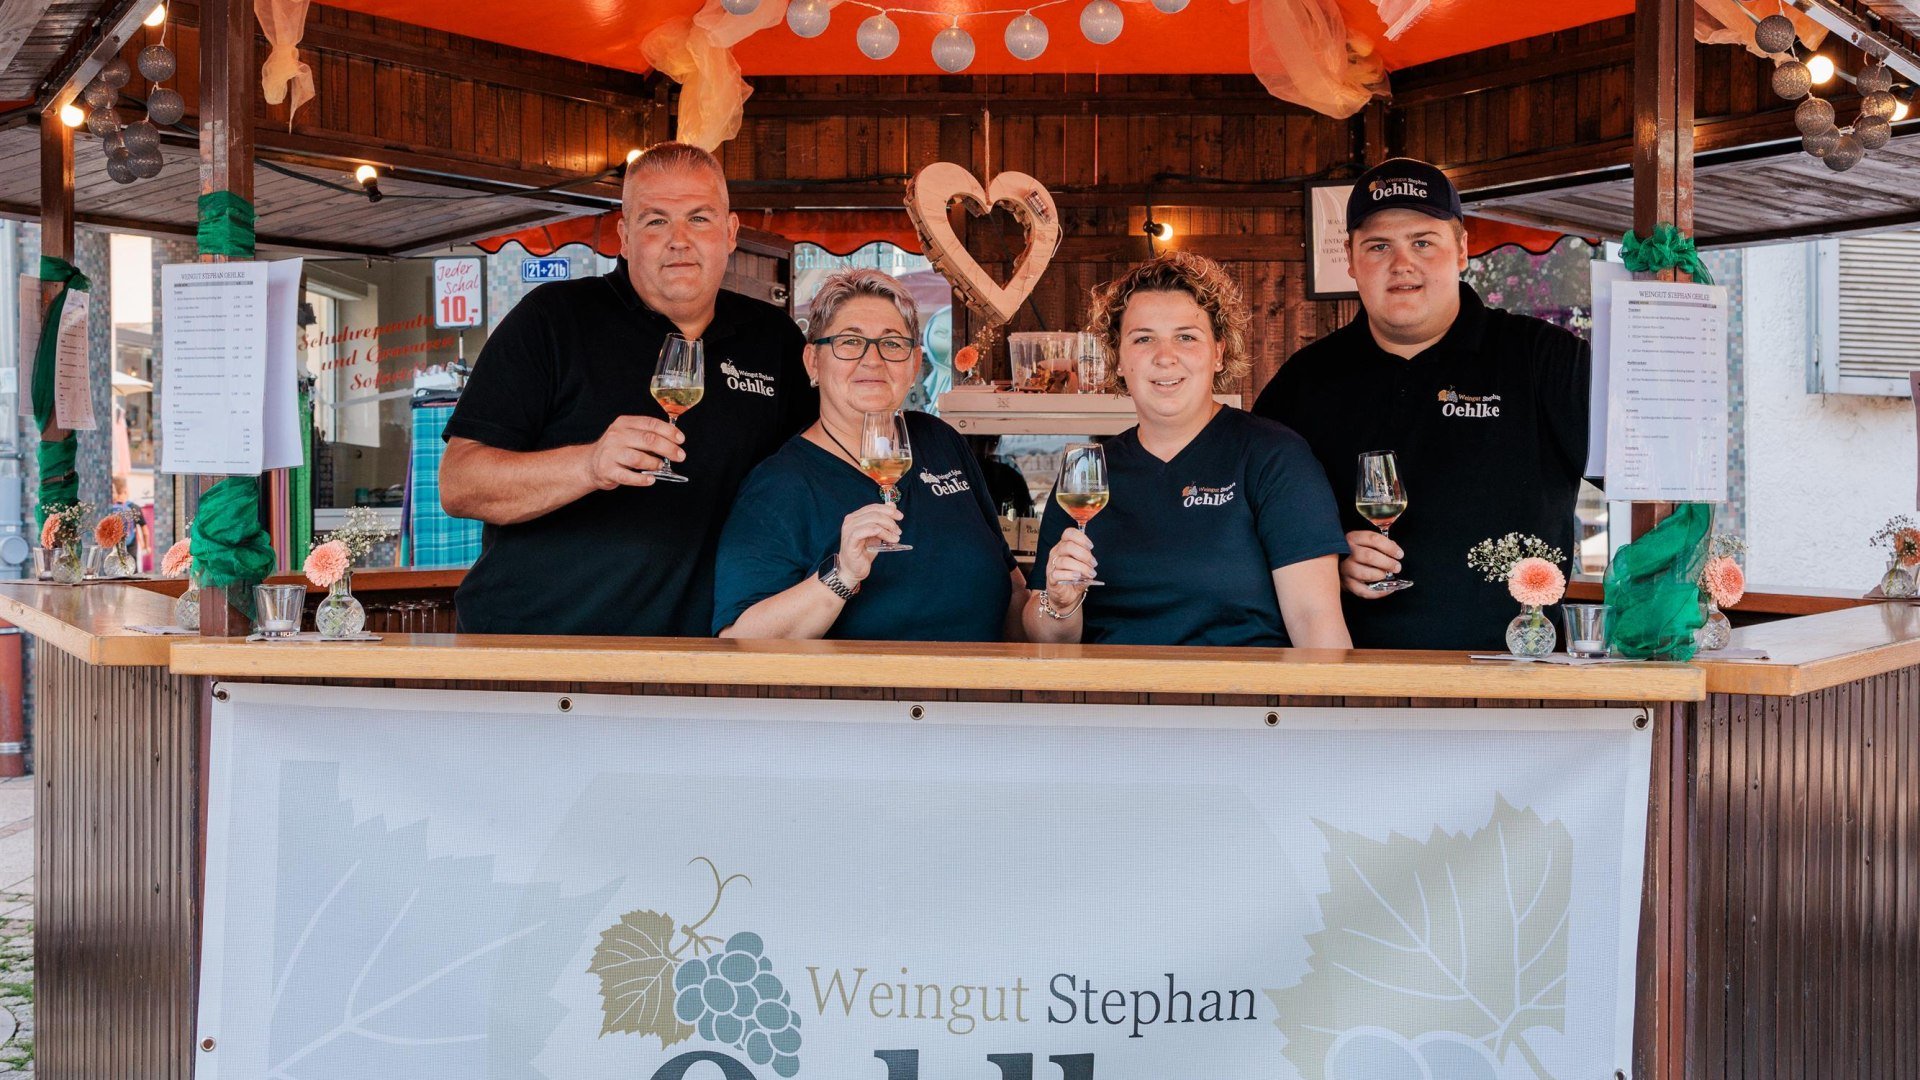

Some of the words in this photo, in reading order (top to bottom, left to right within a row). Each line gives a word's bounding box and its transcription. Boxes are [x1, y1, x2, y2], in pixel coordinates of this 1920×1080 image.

[1372, 182, 1428, 201] Oehlke
[202, 272, 223, 280] STEPHAN
[224, 271, 246, 279] OEHLKE
[437, 261, 473, 281] Jeder
[528, 262, 567, 277] 21+21b
[444, 275, 479, 295] Schal
[1639, 290, 1667, 299] WEINGUT
[1668, 291, 1691, 299] STEPHAN
[298, 312, 435, 350] Schuhreparatu
[321, 350, 358, 371] und
[727, 376, 775, 397] Oehlke
[1442, 402, 1500, 418] Oehlke
[931, 478, 970, 497] Oehlke
[1183, 491, 1234, 508] Oehlke
[805, 966, 1030, 1035] Weingut
[1047, 973, 1258, 1038] Stephan
